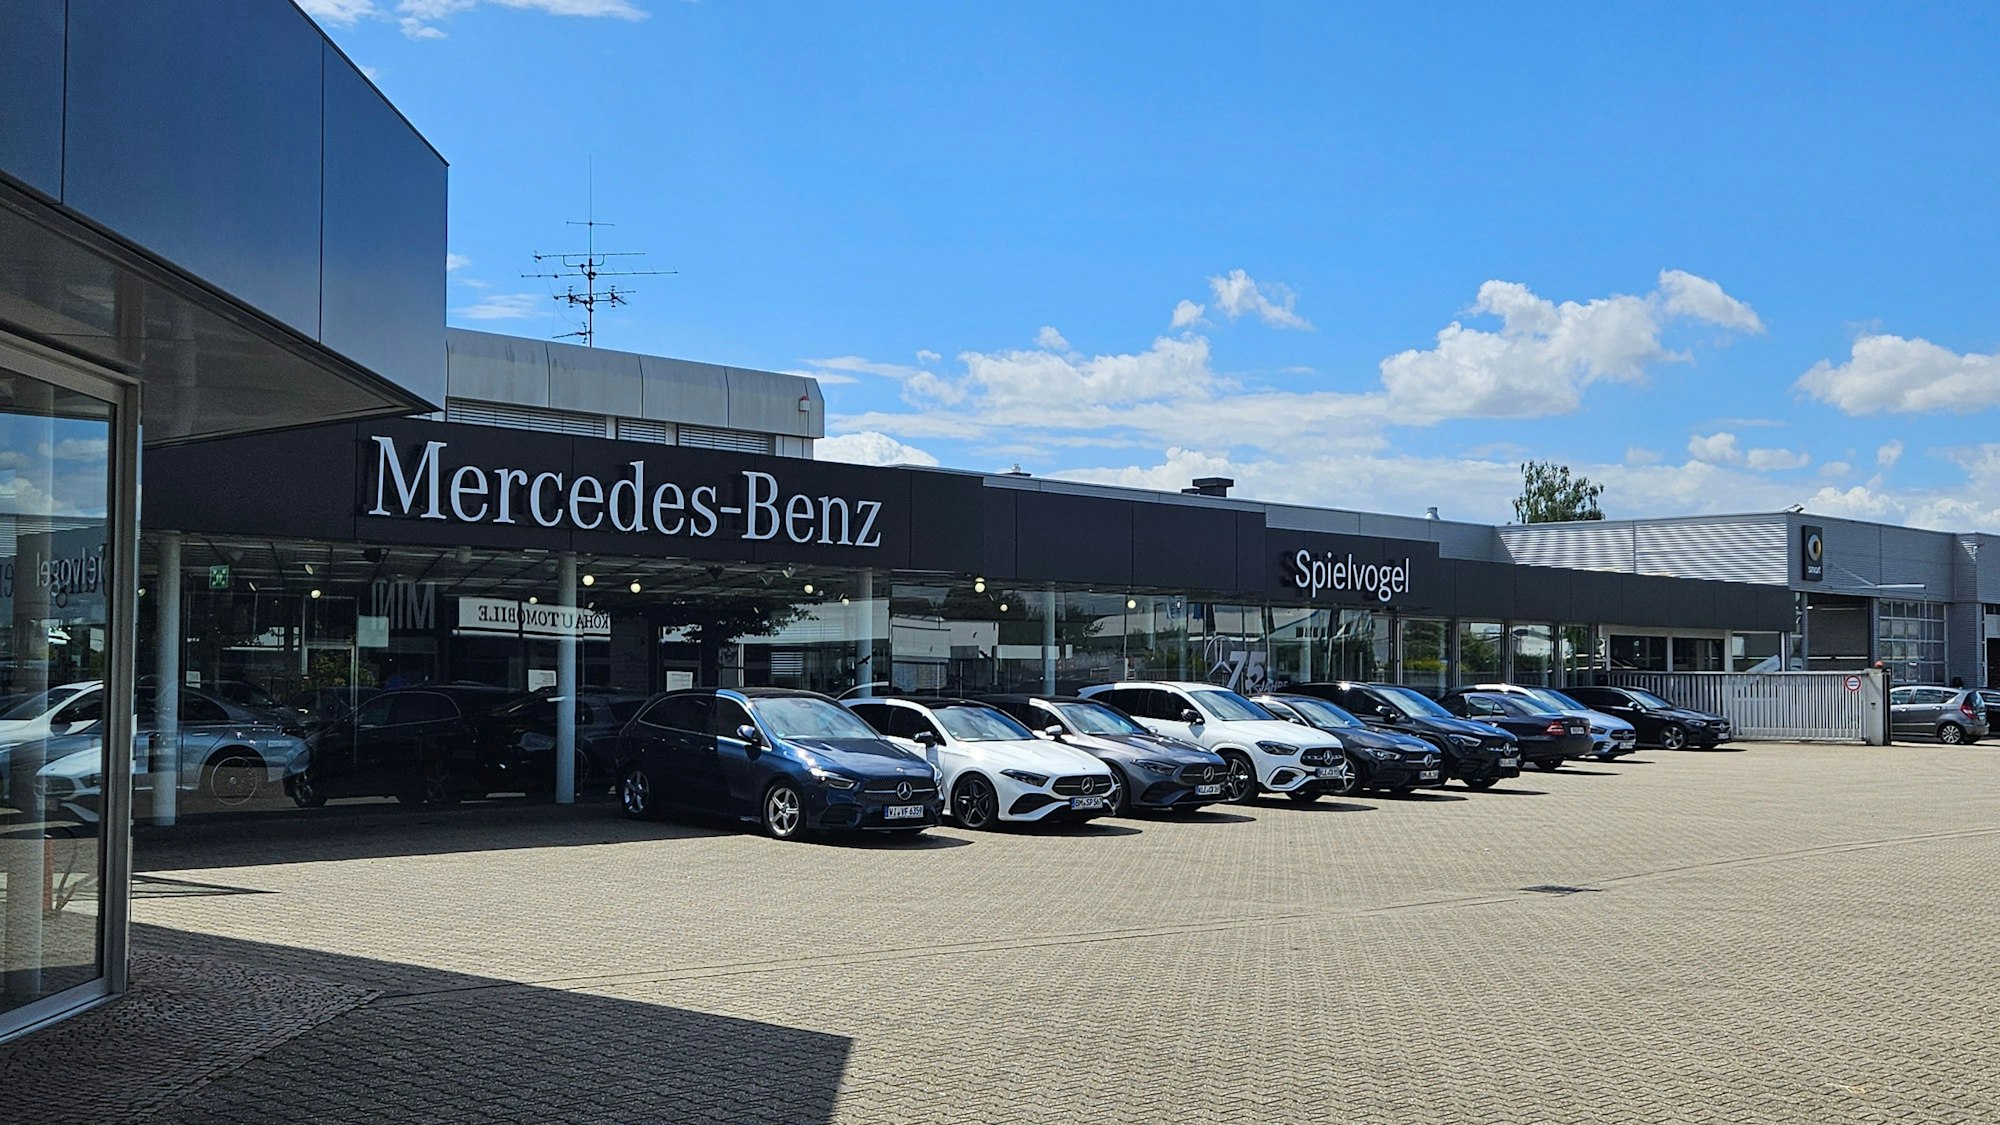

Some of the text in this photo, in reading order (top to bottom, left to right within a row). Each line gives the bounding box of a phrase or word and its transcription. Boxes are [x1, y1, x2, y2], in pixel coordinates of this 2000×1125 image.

[368, 435, 883, 548] Mercedes-Benz
[1295, 549, 1410, 602] Spielvogel
[1227, 650, 1266, 691] 75
